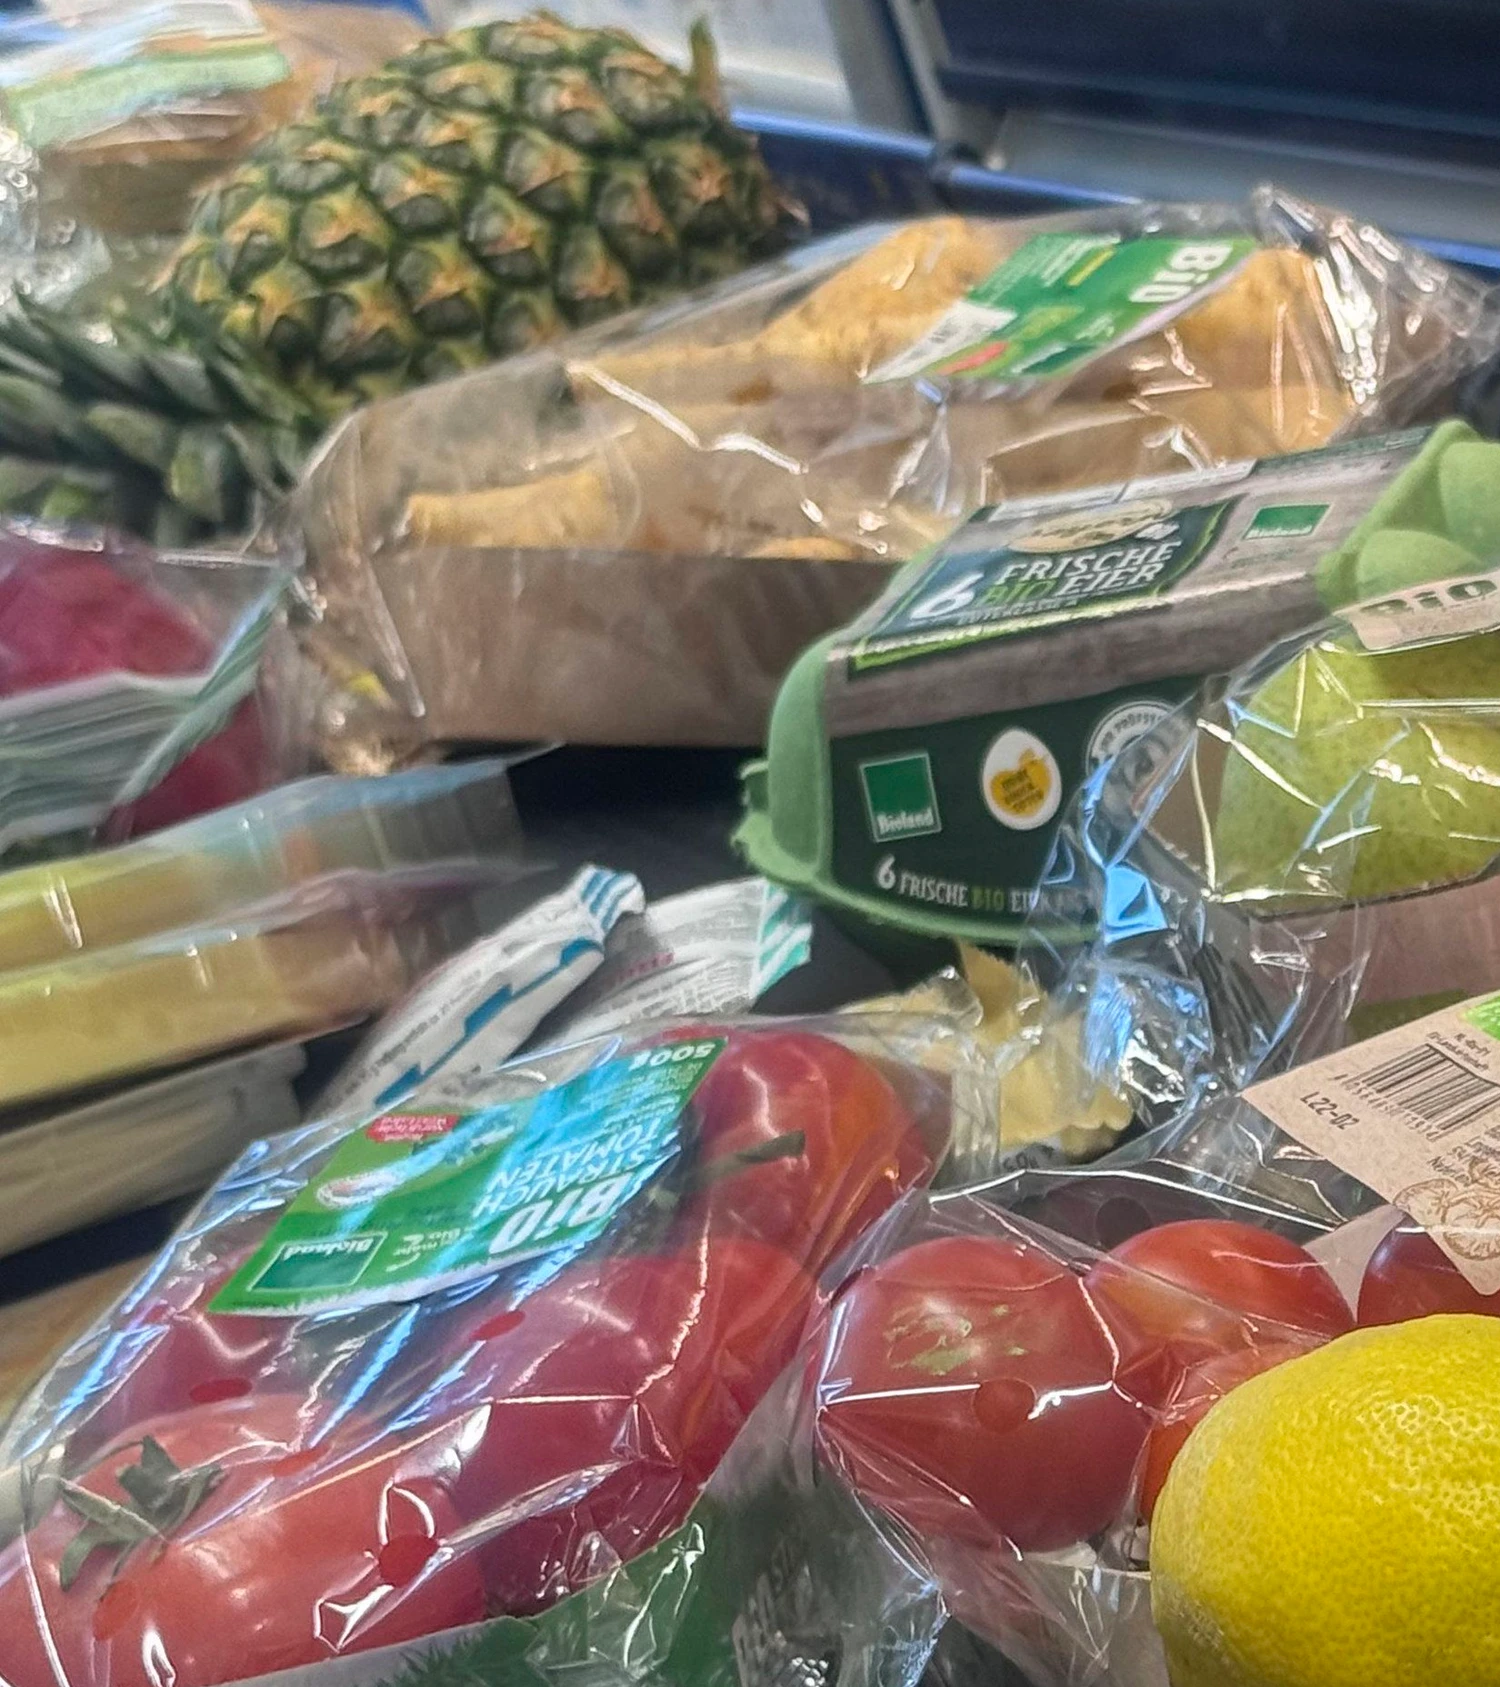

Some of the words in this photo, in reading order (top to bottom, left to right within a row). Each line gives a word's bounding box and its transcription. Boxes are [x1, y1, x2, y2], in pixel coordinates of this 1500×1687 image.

[985, 579, 1056, 604] BIO
[1056, 563, 1165, 598] EIER
[998, 542, 1182, 585] FRISCHE
[910, 573, 983, 619] 6
[876, 808, 935, 834] Bioland
[877, 854, 896, 889] 6
[901, 870, 968, 907] FRISCHE
[971, 887, 1004, 911] BIO
[1299, 1091, 1360, 1130] L22-02
[487, 1117, 662, 1193] TOMATEN
[472, 1150, 646, 1218] STRAUCH
[282, 1238, 375, 1261] Bioland
